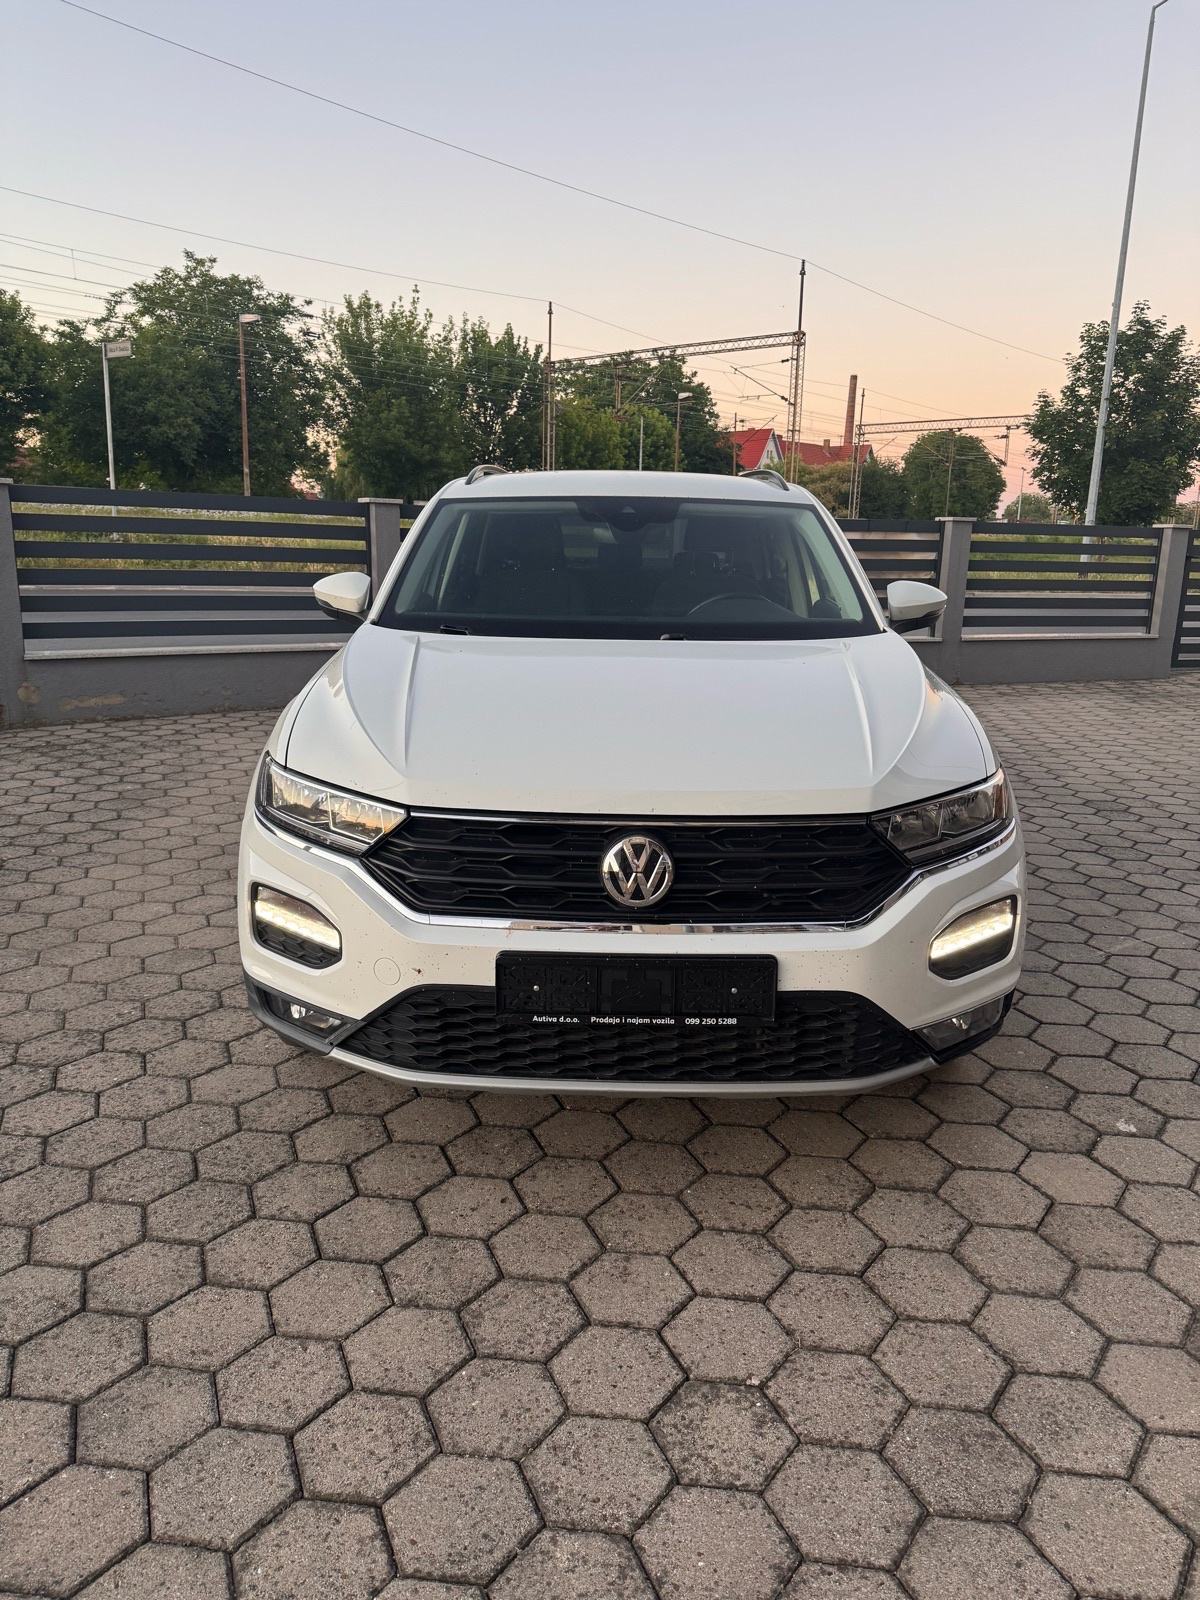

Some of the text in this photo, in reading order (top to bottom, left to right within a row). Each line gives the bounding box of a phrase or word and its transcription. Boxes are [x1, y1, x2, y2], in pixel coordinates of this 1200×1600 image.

[601, 834, 657, 906] VW
[532, 1015, 557, 1023] Autiva
[559, 1015, 580, 1023] d.o.o.
[590, 1016, 621, 1025] Prodaja
[626, 1016, 650, 1025] najam
[652, 1017, 675, 1025] vozila
[684, 1017, 700, 1025] 099
[701, 1017, 717, 1025] 250
[718, 1017, 738, 1025] 5288
